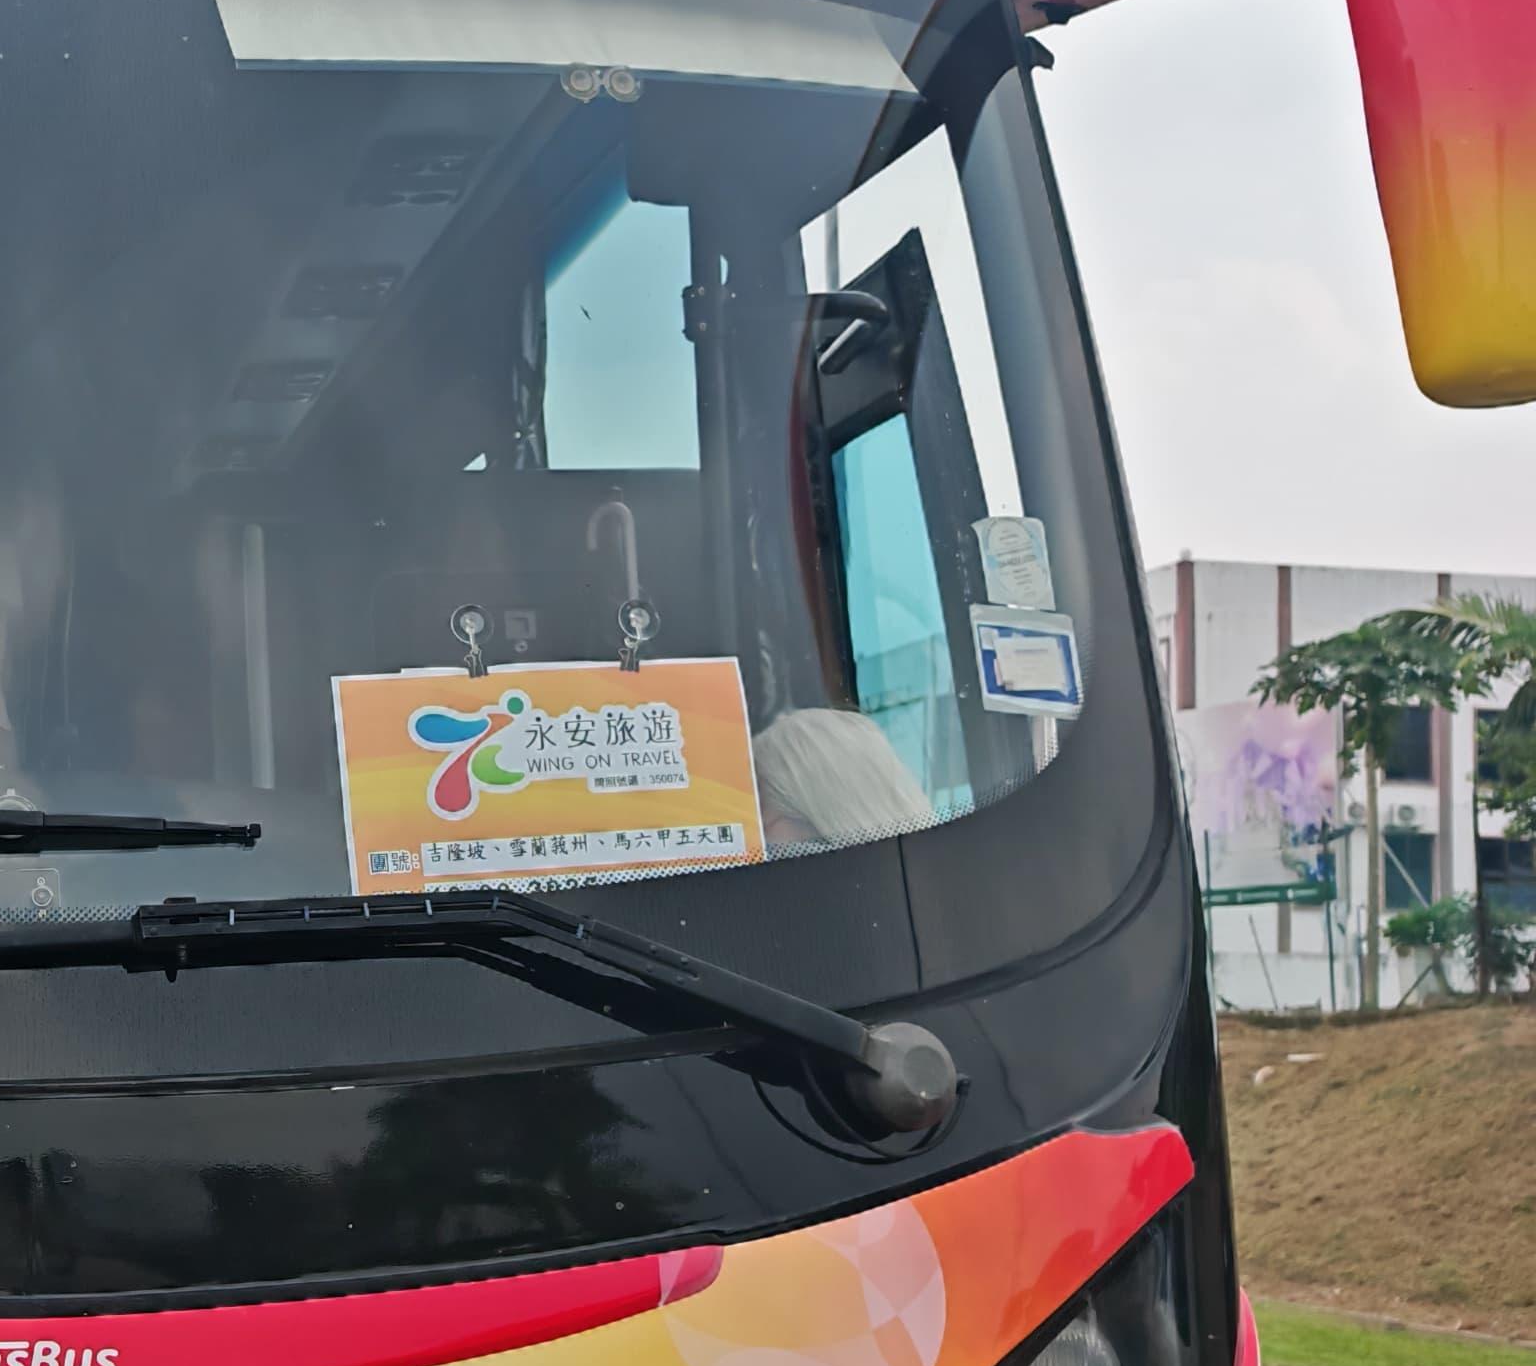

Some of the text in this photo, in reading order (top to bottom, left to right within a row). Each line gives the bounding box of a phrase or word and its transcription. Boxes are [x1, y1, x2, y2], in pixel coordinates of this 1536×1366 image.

[525, 709, 678, 751] 永安旅遊
[526, 750, 680, 773] WING ON TRAVEL
